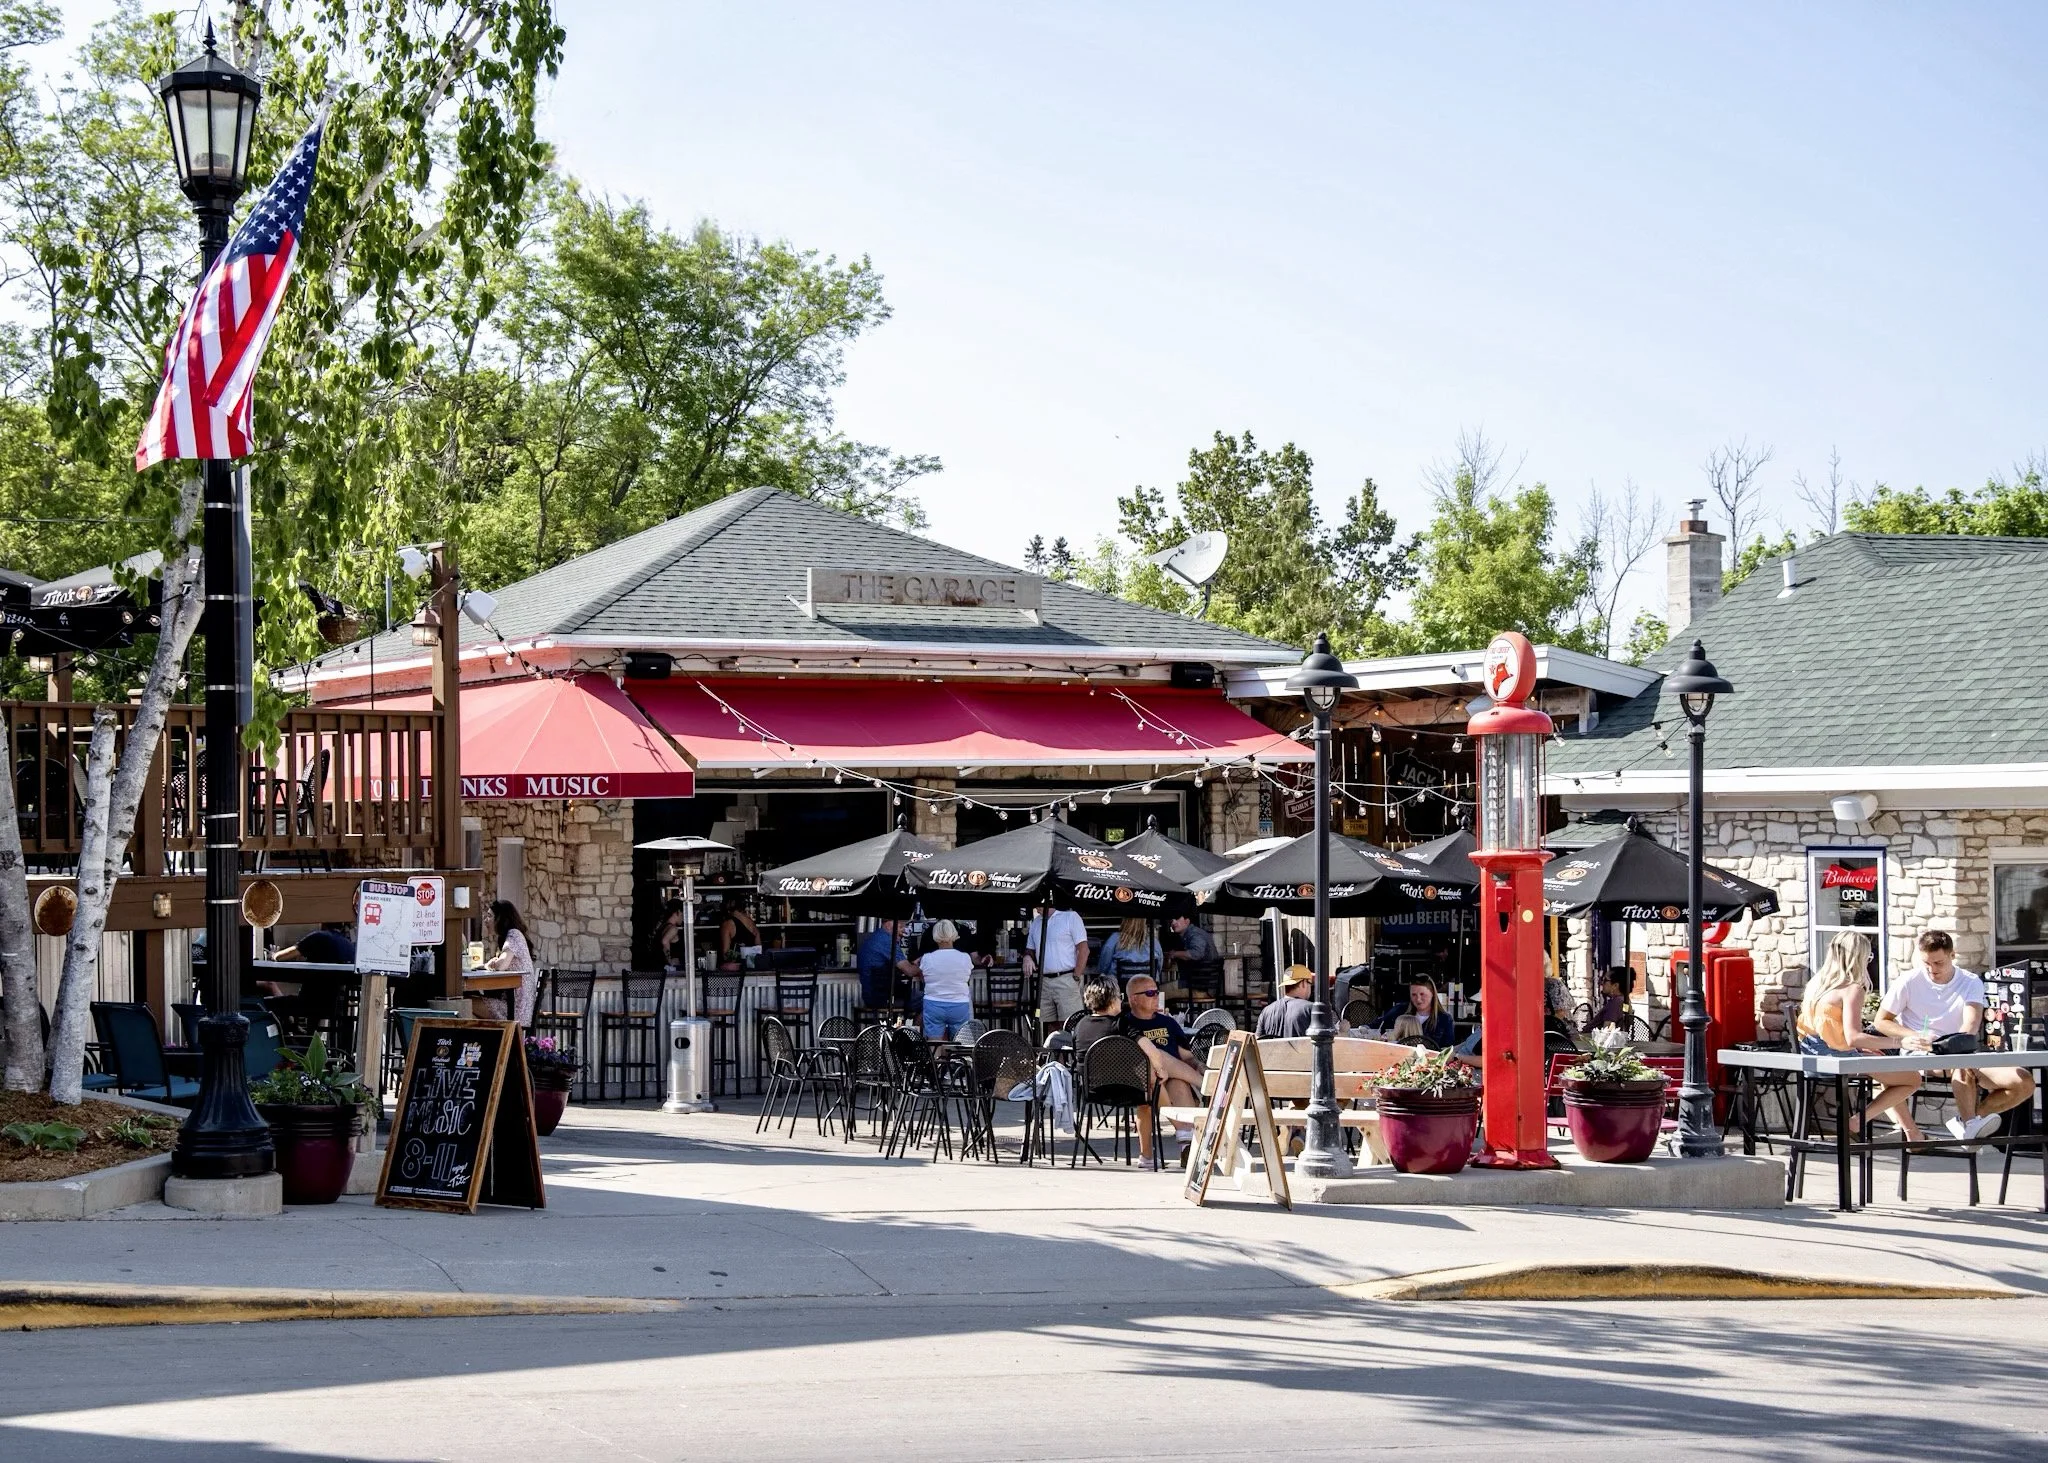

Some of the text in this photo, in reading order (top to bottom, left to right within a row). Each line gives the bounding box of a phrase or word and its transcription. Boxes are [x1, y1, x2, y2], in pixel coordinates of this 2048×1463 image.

[840, 575, 1015, 603] THE GARAGE
[1400, 763, 1437, 785] JACK
[526, 776, 610, 796] MUSIC
[1824, 869, 1878, 884] Budweiser
[368, 883, 409, 895] BUS STOP
[992, 880, 1017, 889] VODKA
[417, 890, 435, 900] STOP
[1842, 889, 1867, 901] OPEN
[1138, 898, 1161, 907] VODKA
[416, 910, 424, 919] 21
[1381, 912, 1414, 926] COLD
[1416, 910, 1450, 925] BEER
[401, 1138, 458, 1182] 8-11
